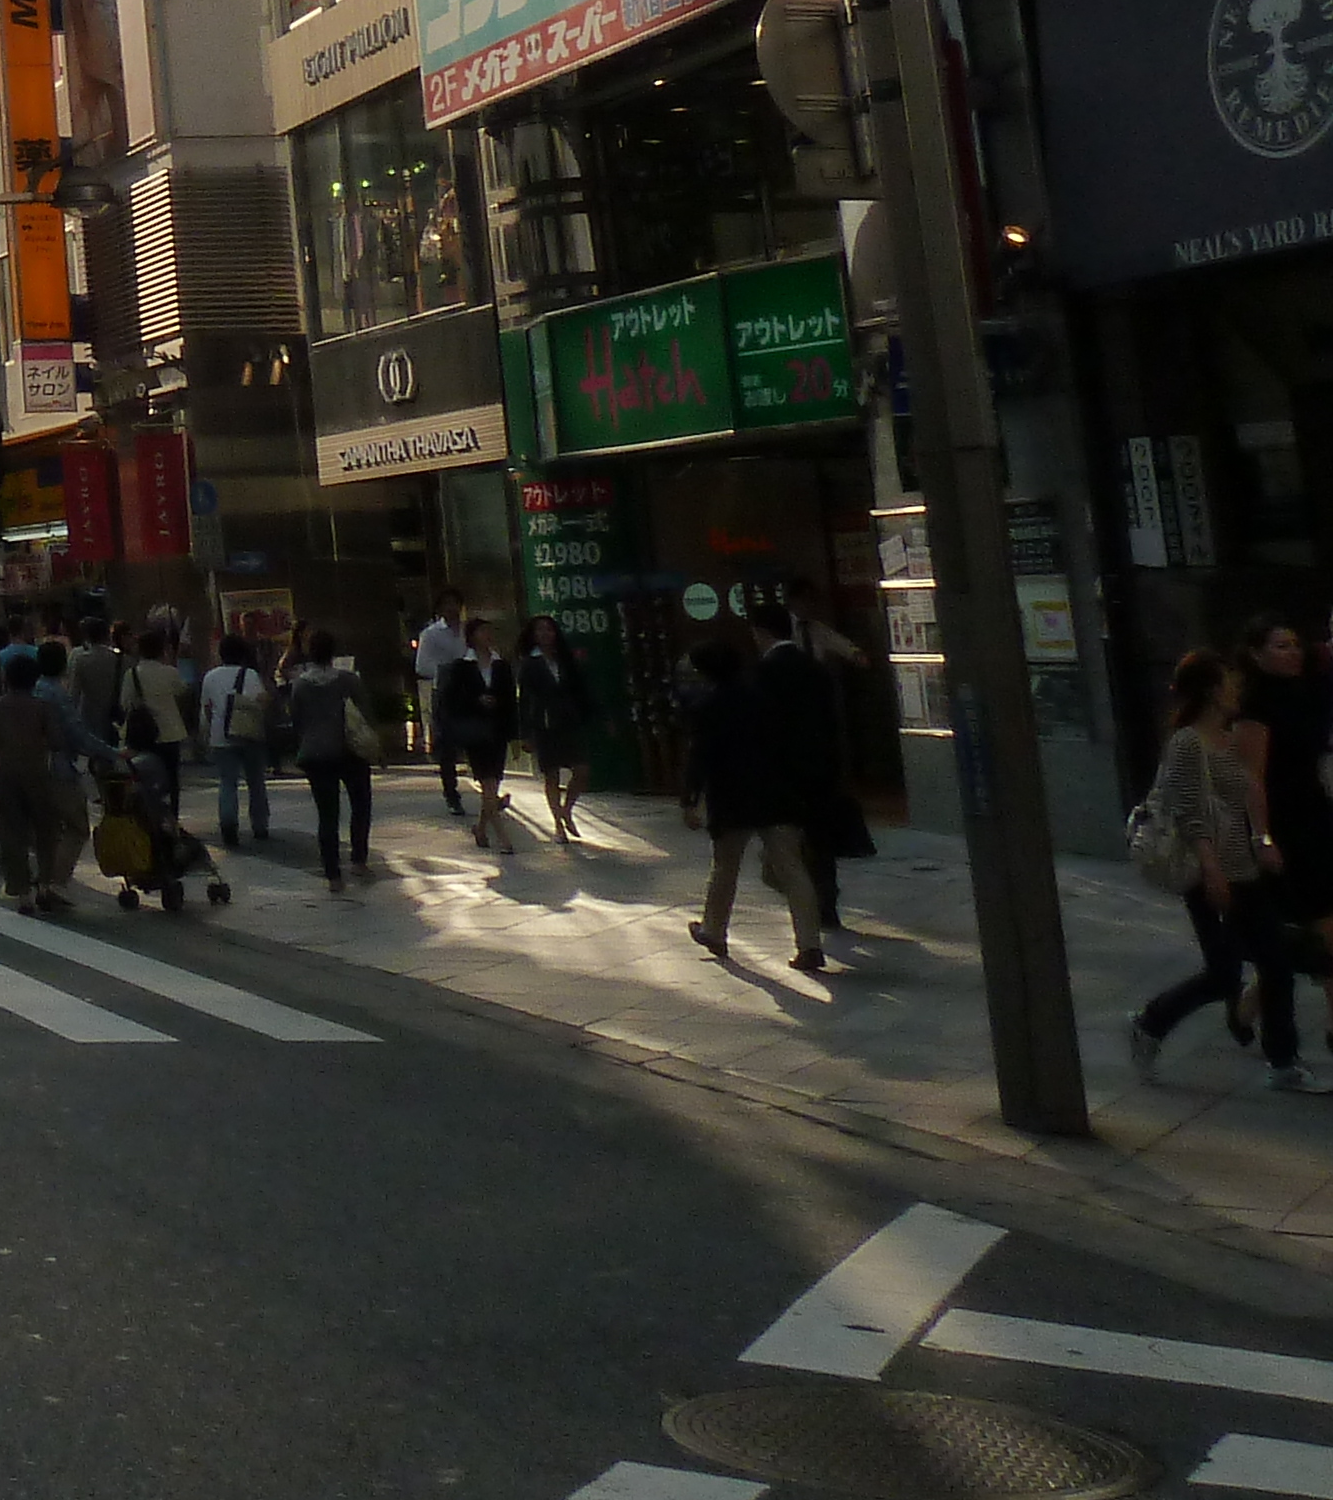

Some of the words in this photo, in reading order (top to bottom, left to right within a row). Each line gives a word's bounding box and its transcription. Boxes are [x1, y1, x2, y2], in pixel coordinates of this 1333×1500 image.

[430, 73, 458, 115] 2F
[461, 42, 524, 103] メガネ
[546, 0, 618, 65] スーパー
[1173, 225, 1244, 265] NEAL'S
[1245, 214, 1307, 251] YARD
[609, 295, 697, 341] アウトレット
[736, 308, 841, 347] アウトレット
[26, 365, 71, 381] ネイル
[27, 382, 71, 398] サロン
[579, 323, 709, 432] Hatch
[337, 437, 409, 472] SAMANTHA
[408, 426, 481, 461] THAVASA
